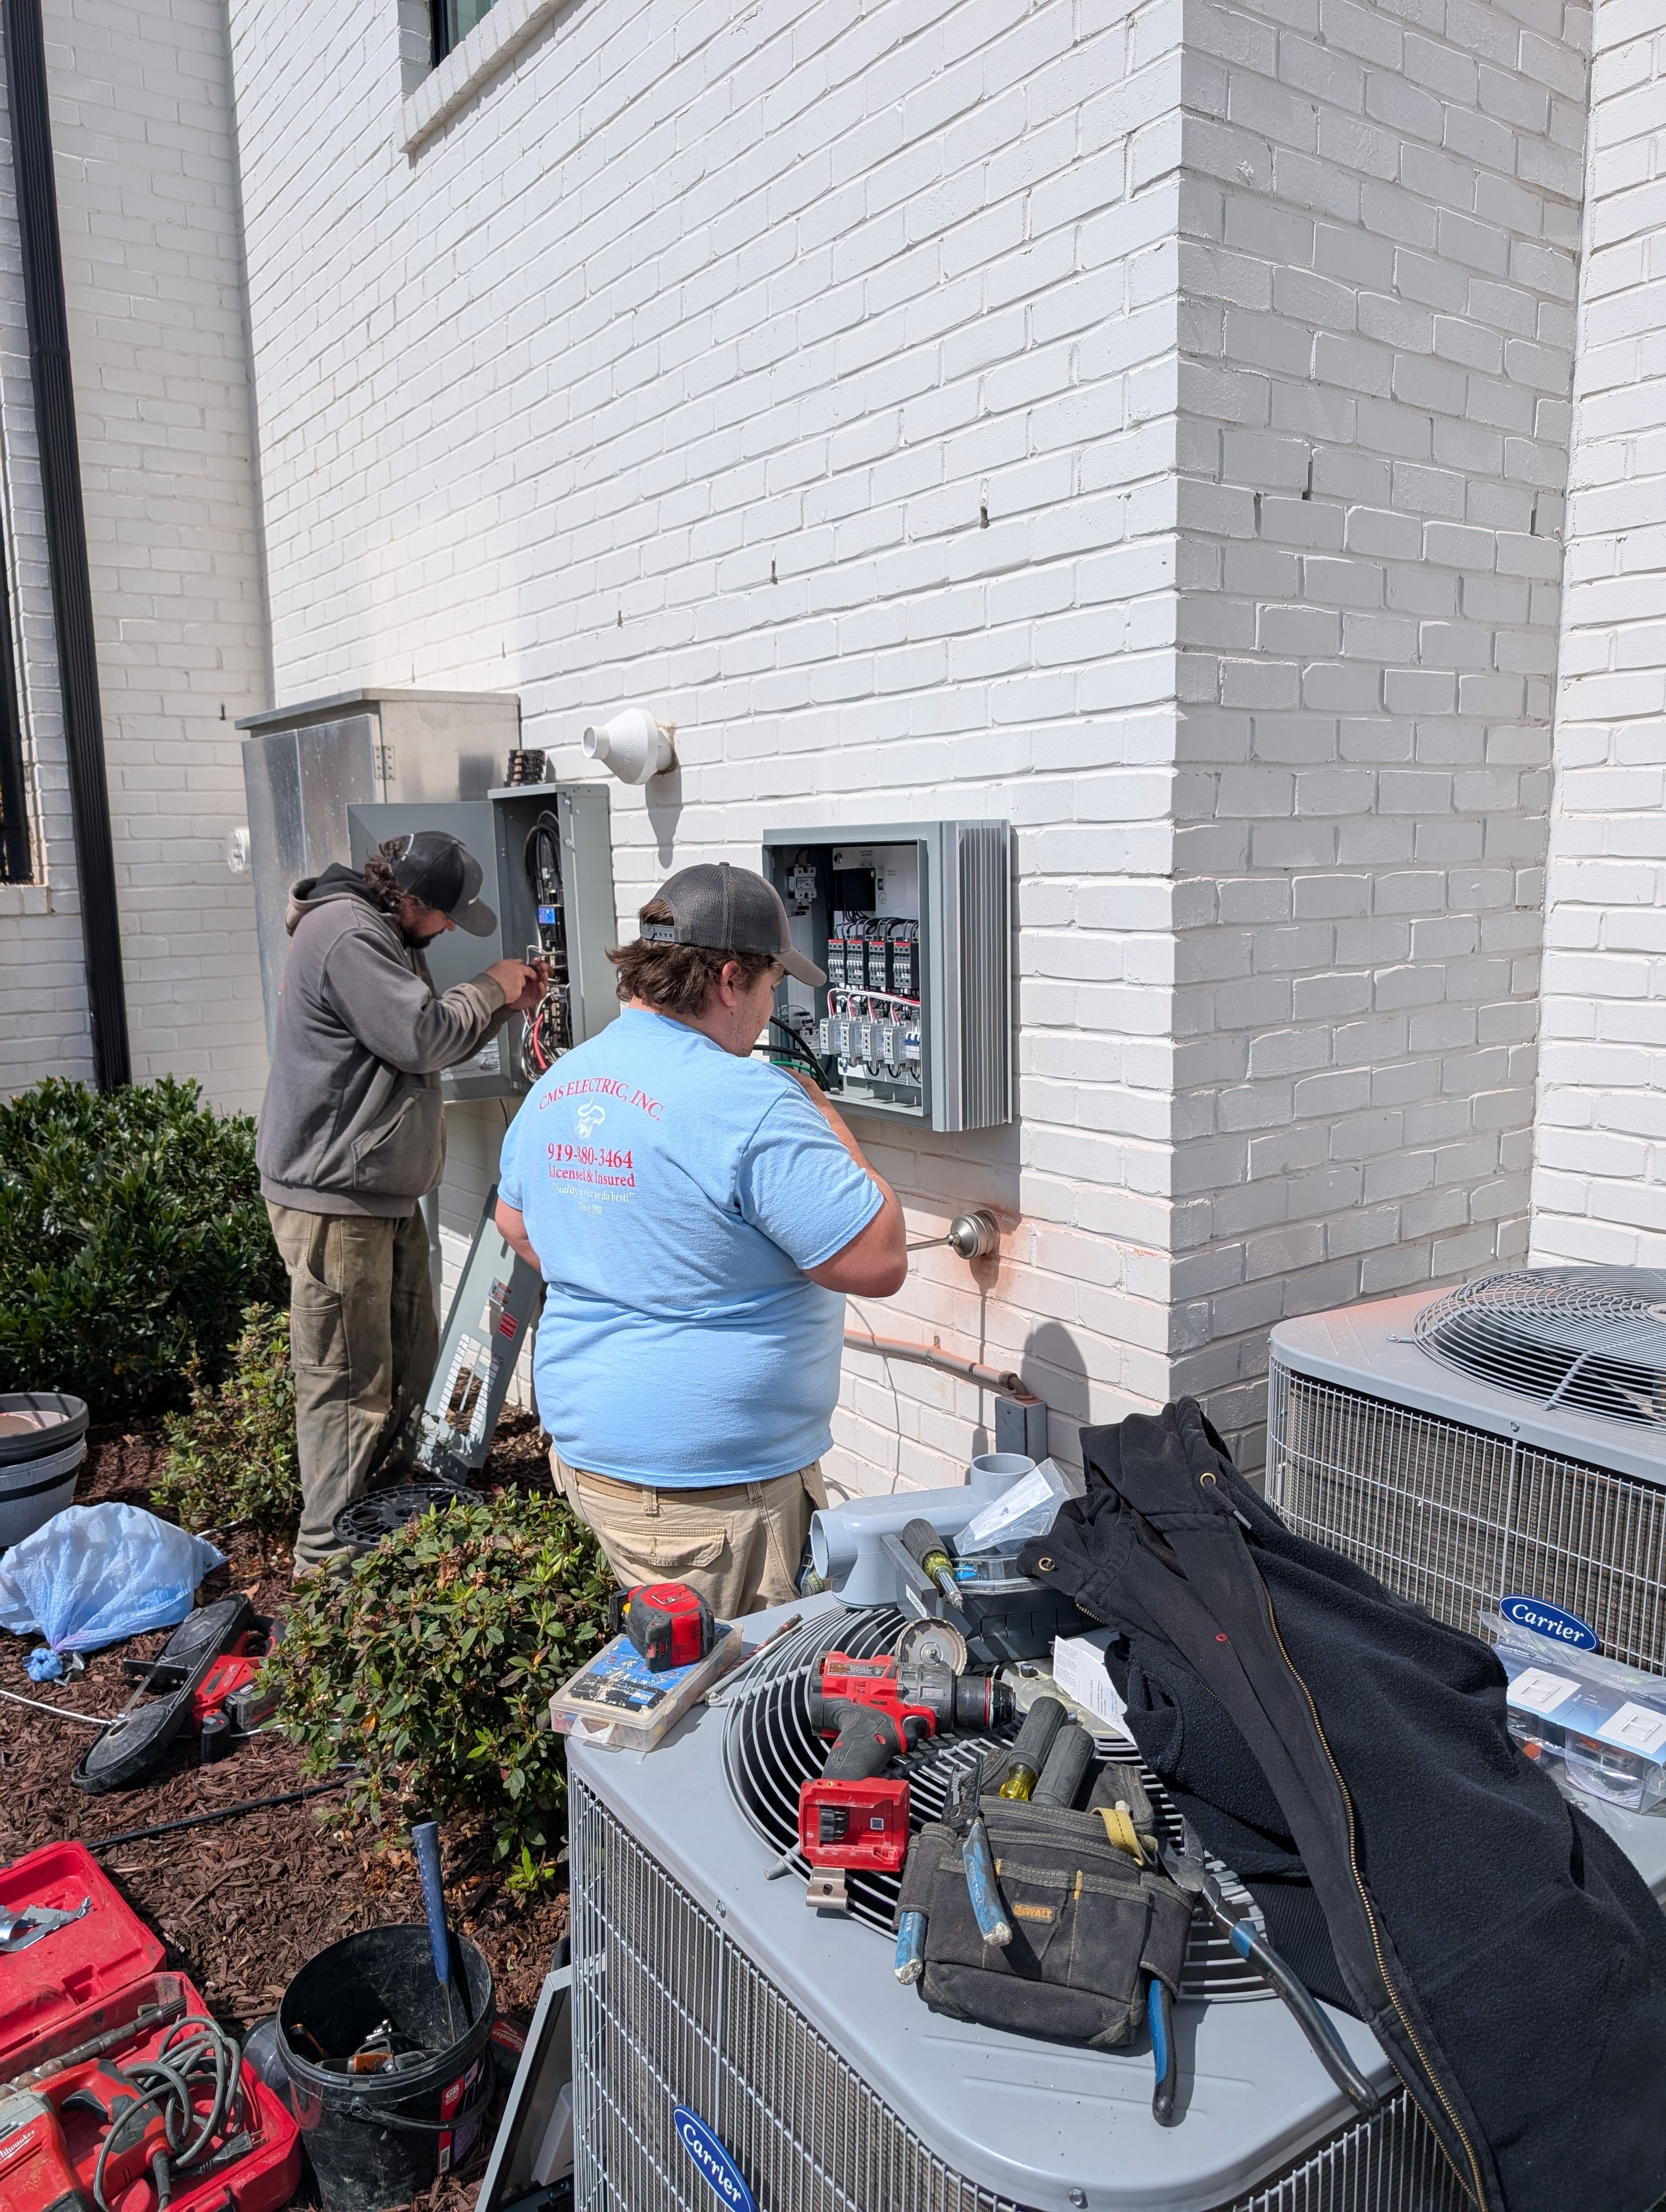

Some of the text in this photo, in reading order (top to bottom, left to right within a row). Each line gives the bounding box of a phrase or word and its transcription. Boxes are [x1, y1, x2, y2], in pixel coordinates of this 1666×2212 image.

[539, 1077, 664, 1121] CMS ELECTRIC, INC.
[548, 1143, 633, 1169] 919-880-3464
[587, 1169, 593, 1183] &
[595, 1170, 636, 1187] Insured
[601, 1192, 610, 1201] do
[579, 1201, 602, 1215] Since 1998
[1512, 1604, 1585, 1642] Carrier
[501, 2022, 518, 2035] STUD
[445, 2084, 460, 2099] GB
[683, 2124, 741, 2202] Carrier
